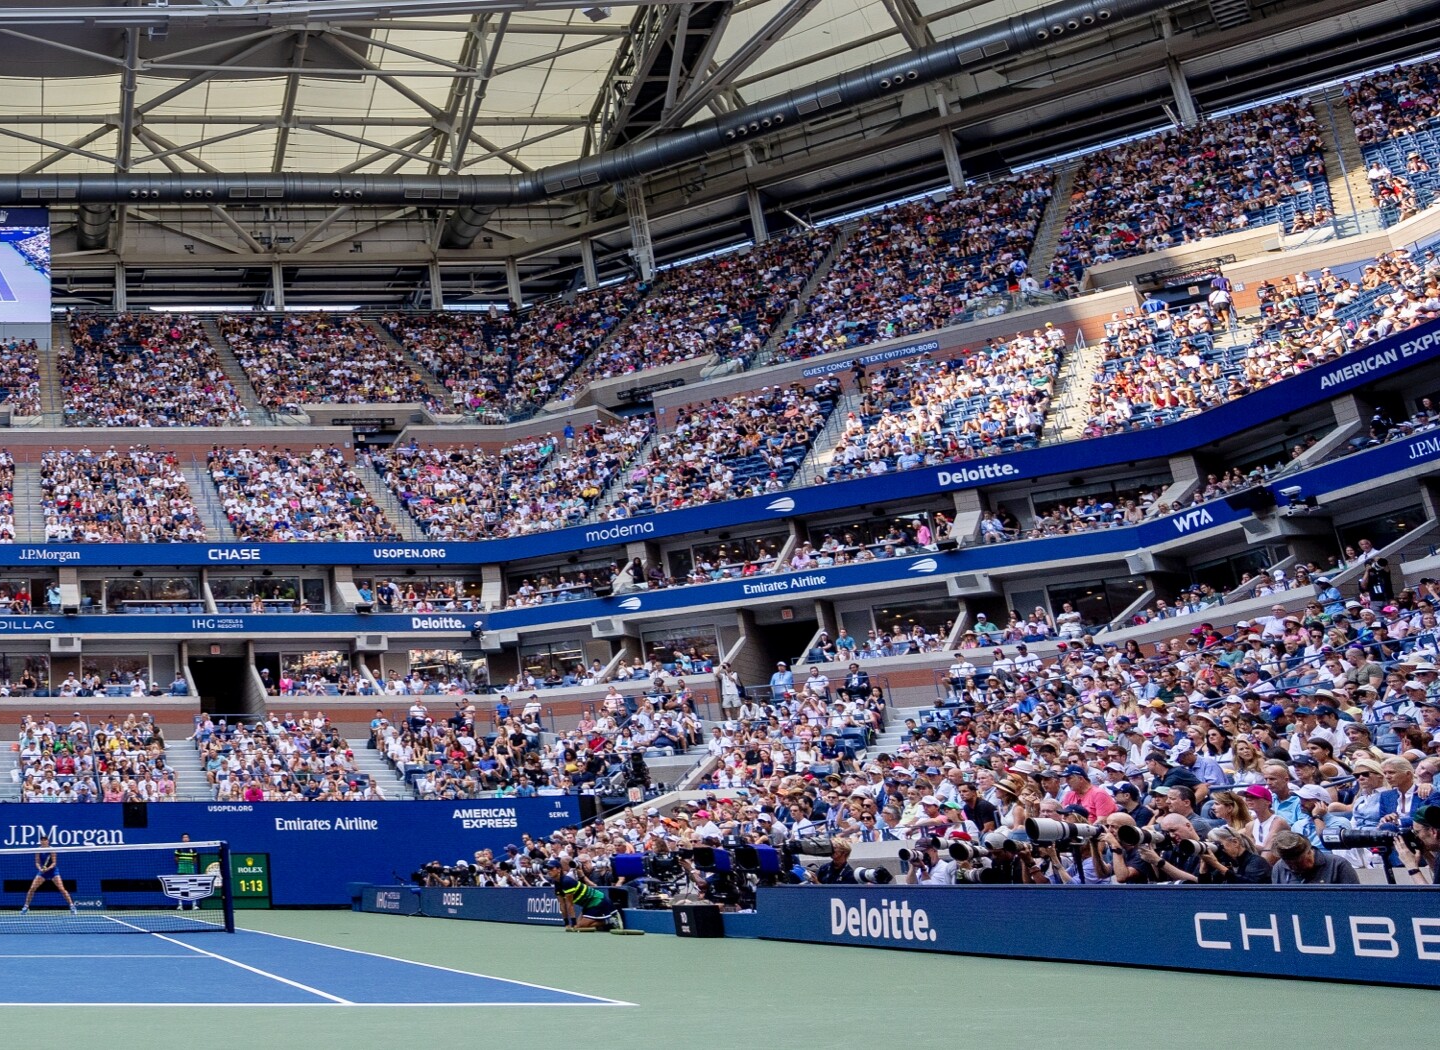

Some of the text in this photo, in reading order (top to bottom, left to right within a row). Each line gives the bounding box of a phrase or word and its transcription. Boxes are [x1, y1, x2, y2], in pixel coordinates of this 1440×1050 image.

[803, 342, 938, 377] GUEST CONCE? TEXT (917)708-8080
[1321, 348, 1397, 390] AMERICAN
[937, 462, 1019, 487] Deloitte.
[1173, 508, 1214, 534] WTA
[586, 521, 654, 542] moderna
[19, 549, 80, 562] J.P.Morgan
[208, 549, 260, 559] CHASE
[374, 549, 445, 558] USOPEN.ORG
[743, 574, 827, 595] Emirates Airline
[192, 619, 215, 629] IHG
[412, 617, 466, 629] Deloitte.
[453, 808, 516, 818] AMERICAN
[275, 817, 377, 830] Emirates Airline
[463, 818, 517, 828] EXPRESS
[4, 825, 125, 847] J.P.Morgan
[240, 880, 262, 891] 1:13
[376, 892, 387, 908] IHG
[443, 893, 463, 905] DOBEL
[831, 898, 936, 941] Deloitte.
